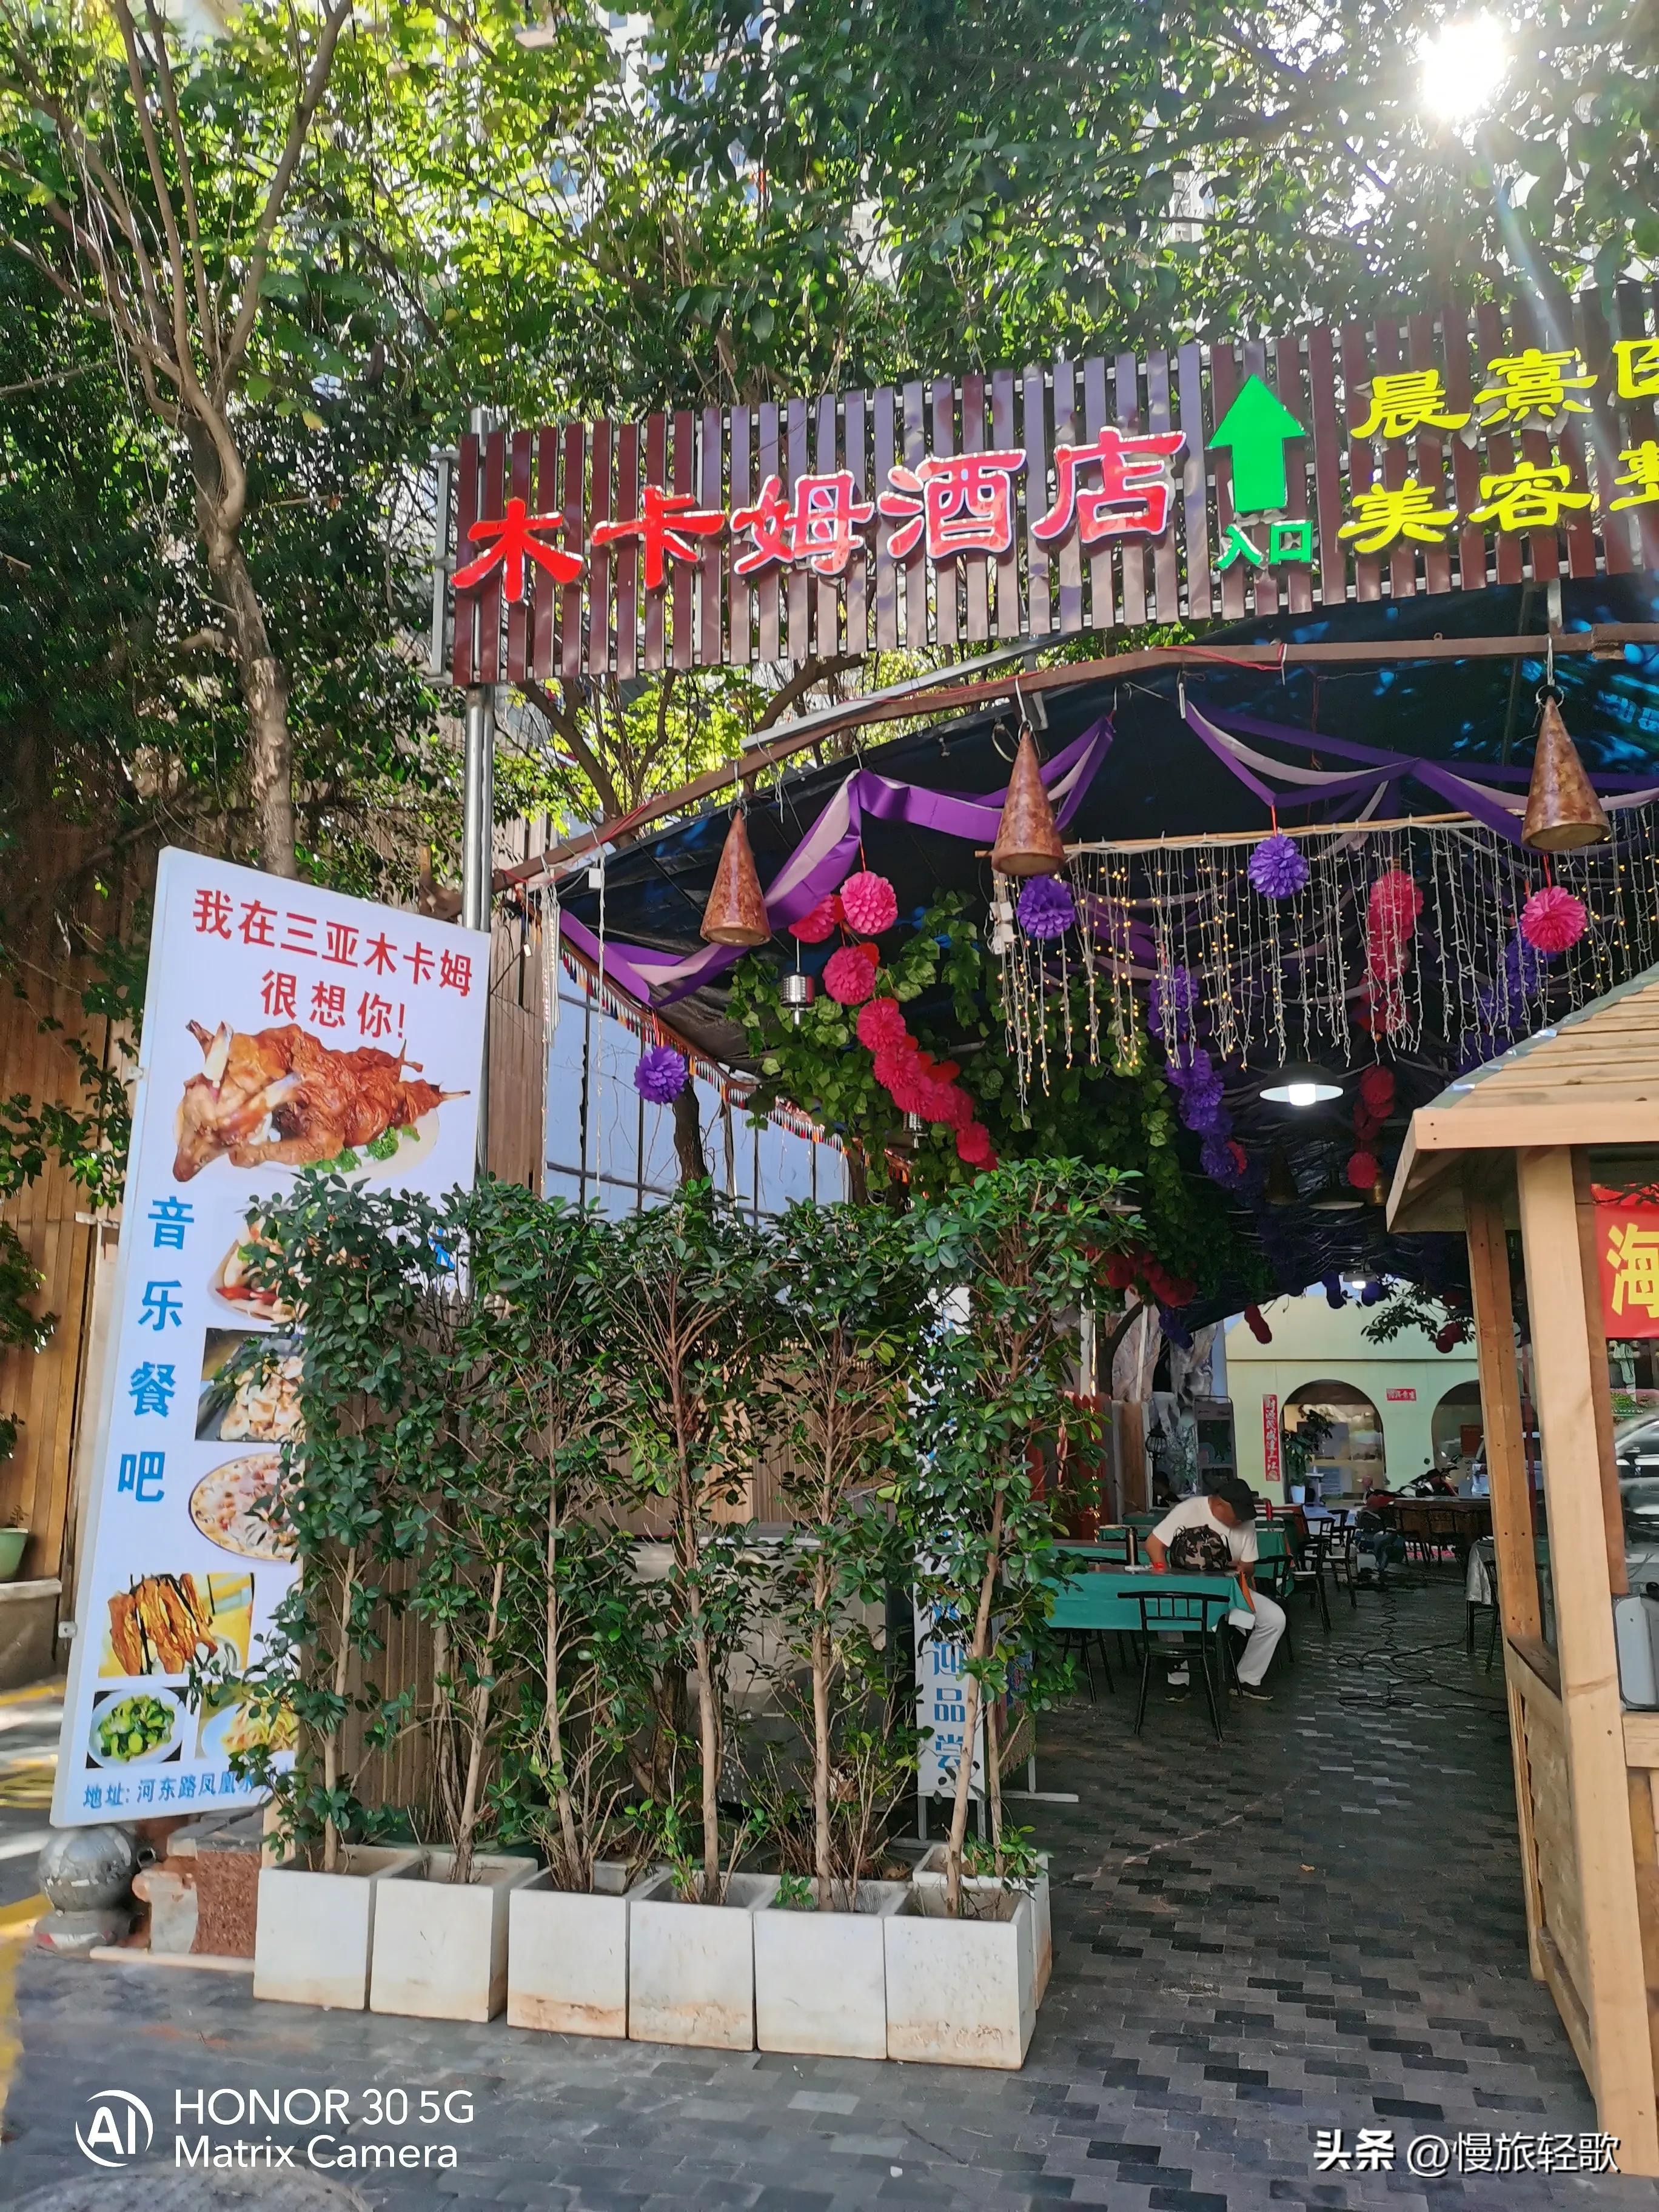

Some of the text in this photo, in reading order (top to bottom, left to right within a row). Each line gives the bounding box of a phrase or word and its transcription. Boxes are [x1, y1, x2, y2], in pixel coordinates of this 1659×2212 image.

[451, 426, 1187, 603] 木卡姆酒店
[1216, 520, 1313, 570] 入口
[193, 888, 473, 997] 我在三亚木卡姆
[261, 968, 406, 1039] 很想你!
[1606, 1222, 1659, 1318] 海
[118, 1196, 195, 1503] 音乐餐吧
